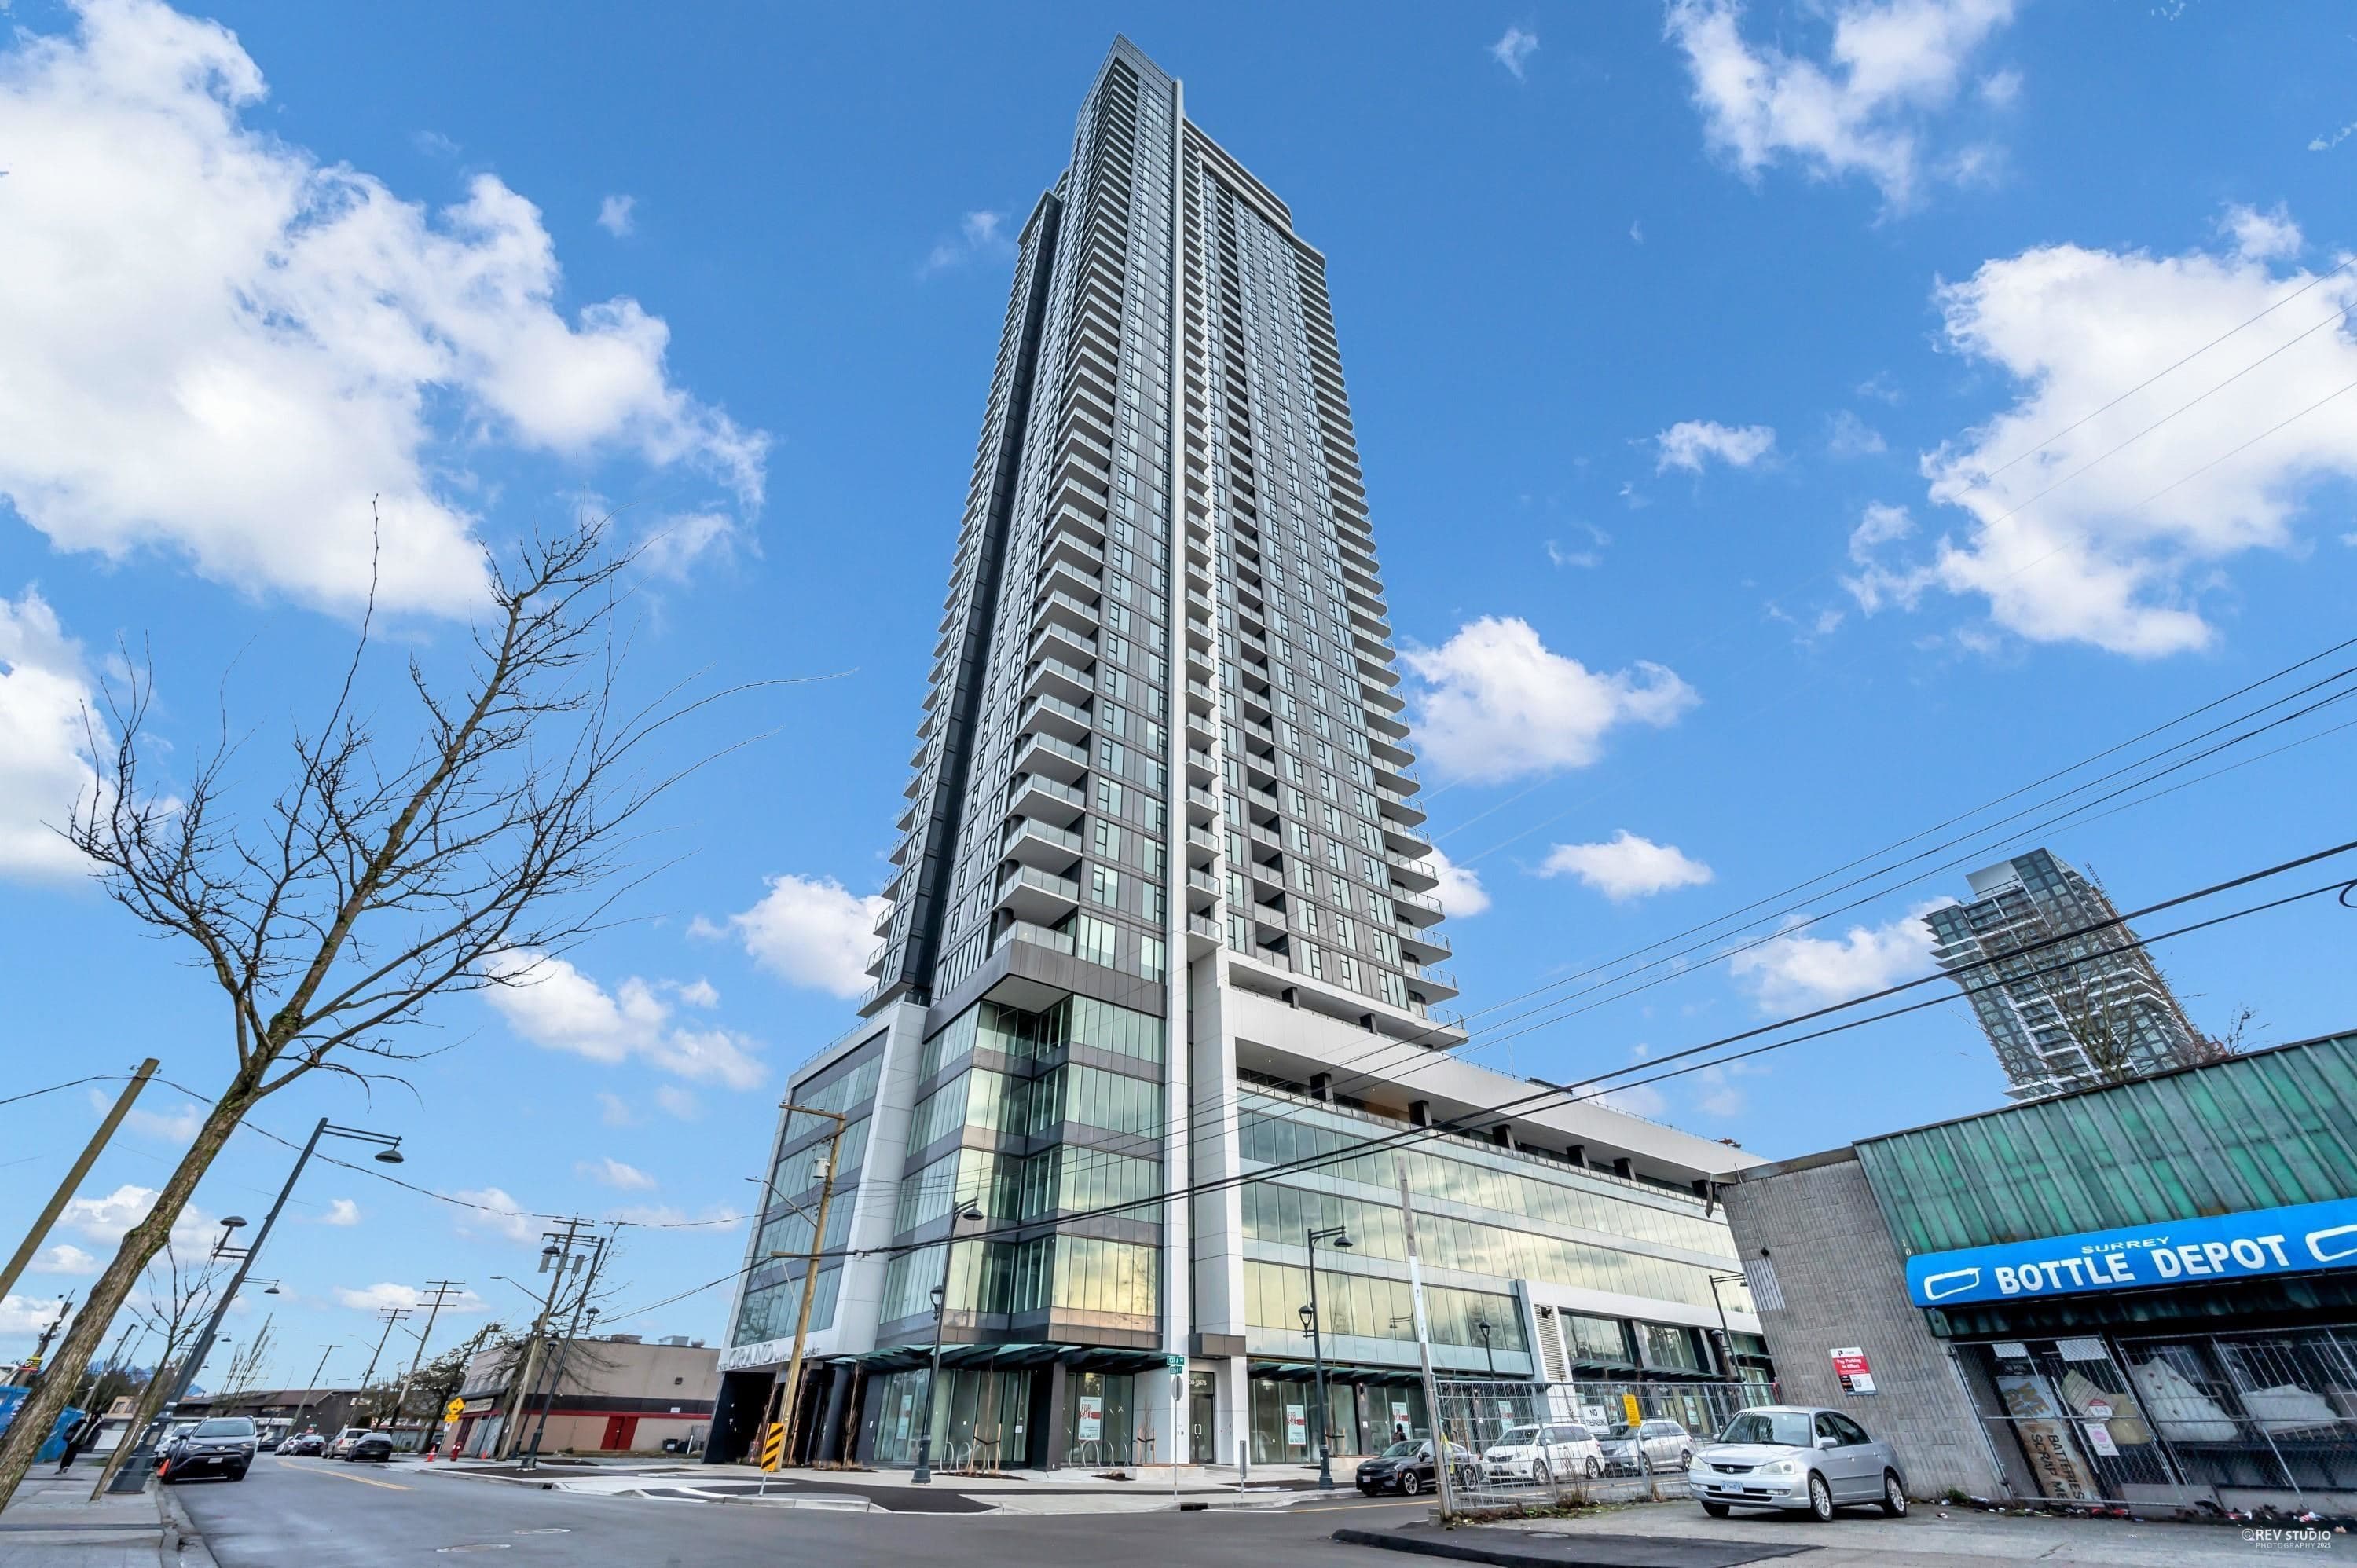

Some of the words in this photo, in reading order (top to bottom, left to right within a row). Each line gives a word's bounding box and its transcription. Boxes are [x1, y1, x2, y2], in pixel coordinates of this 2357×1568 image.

[2081, 1236, 2170, 1254] SURREY
[1994, 1252, 2135, 1295] BOTTLE
[2150, 1234, 2290, 1278] DEPOT
[729, 1343, 774, 1368] GRAND
[1080, 1411, 1092, 1420] SALE
[1081, 1403, 1091, 1412] FOR
[2031, 1434, 2058, 1476] SCRAP
[2047, 1434, 2085, 1500] BATTERIES
